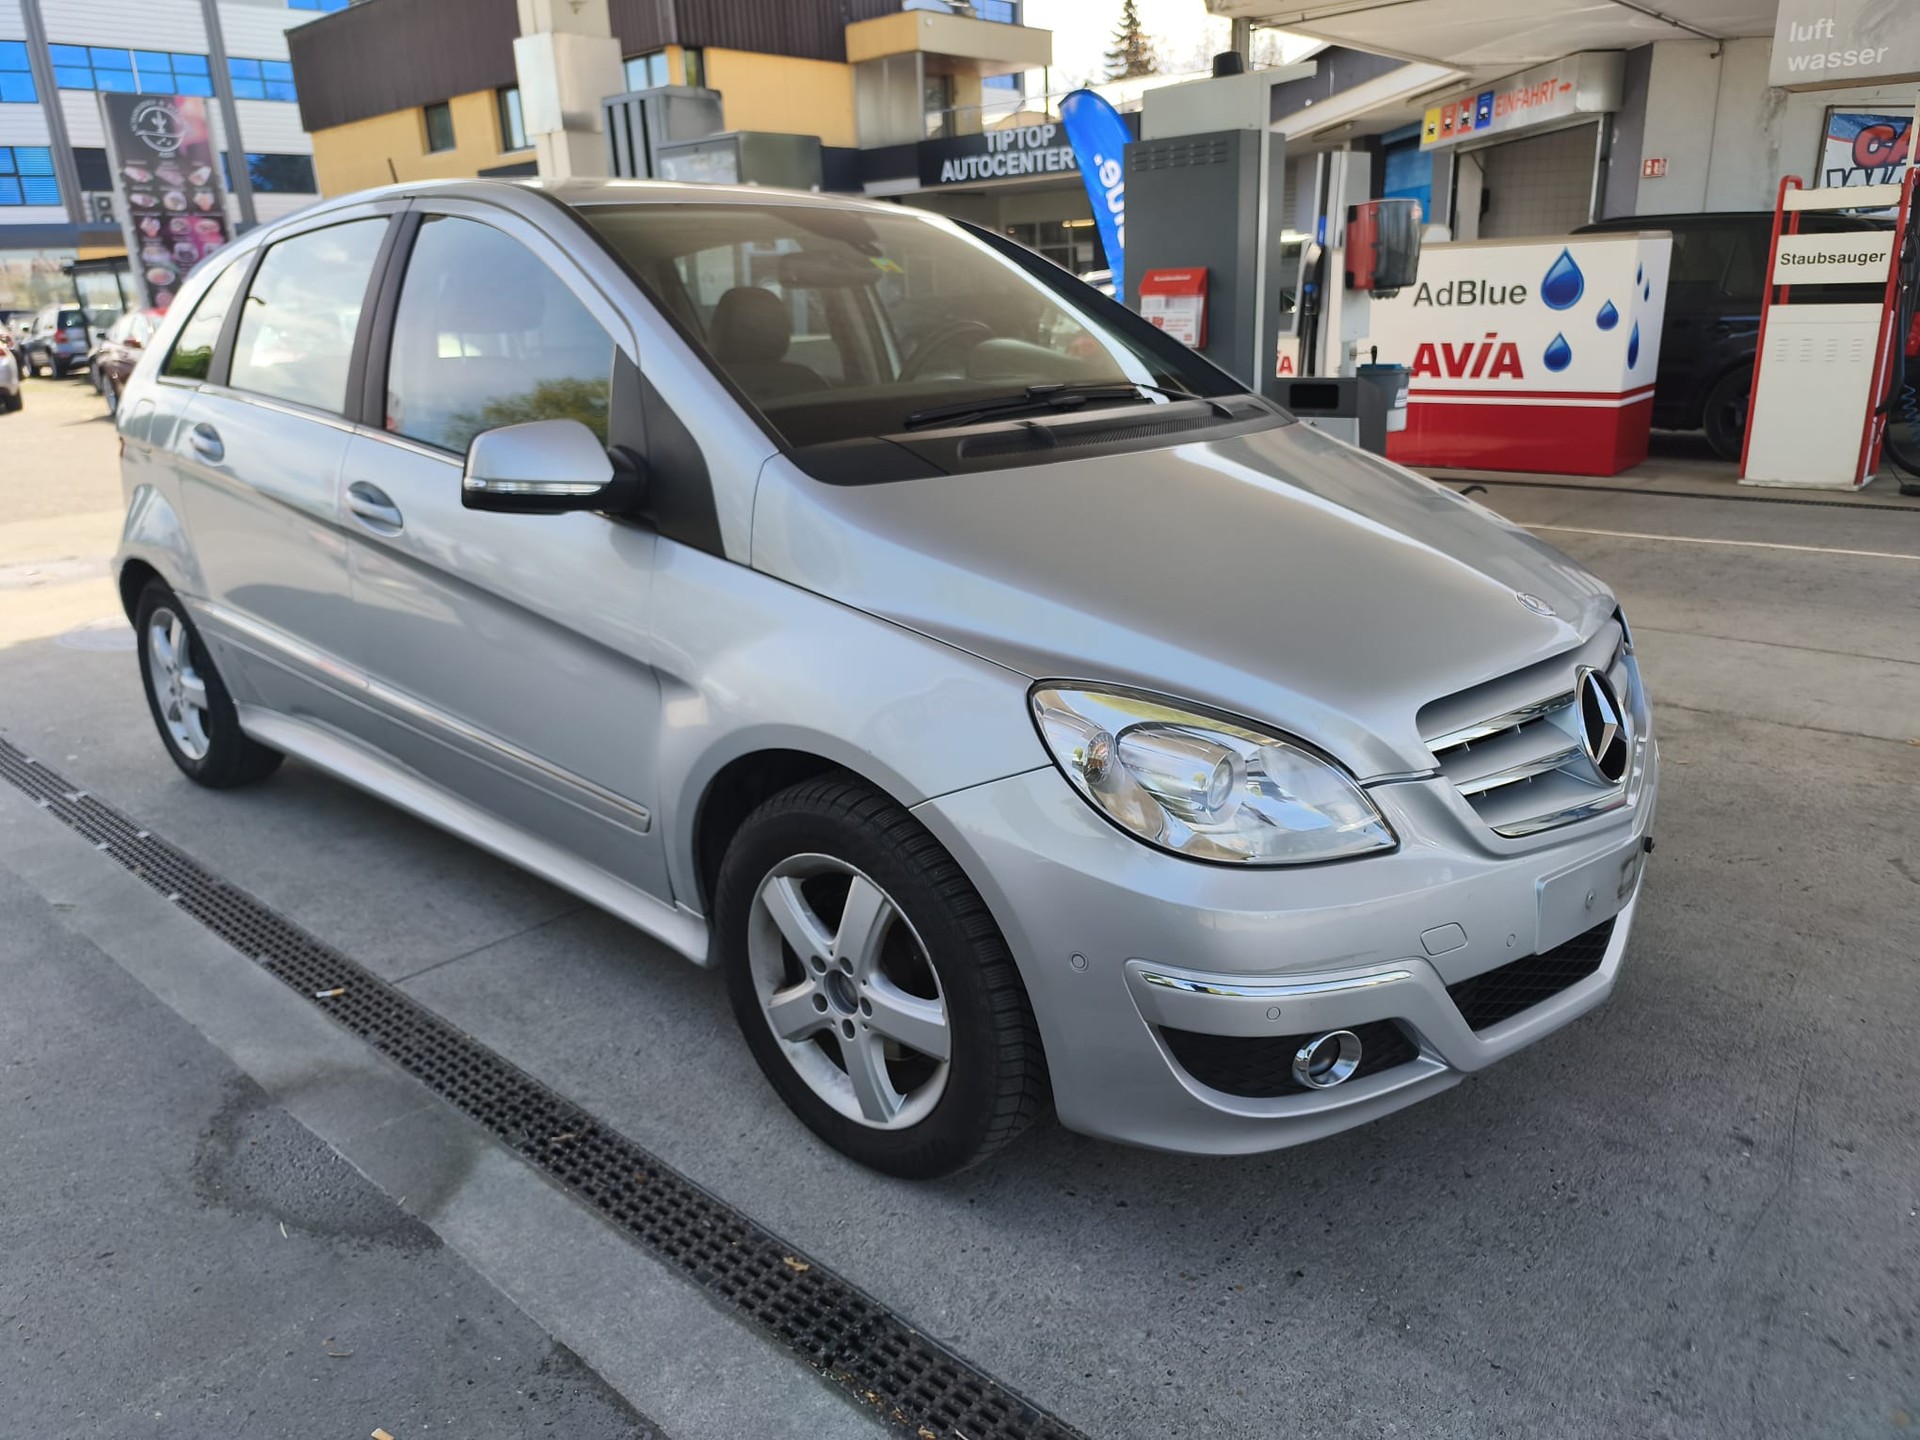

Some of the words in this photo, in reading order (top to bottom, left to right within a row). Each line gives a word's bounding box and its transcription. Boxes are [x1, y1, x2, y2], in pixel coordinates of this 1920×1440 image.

[1789, 18, 1835, 42] luft
[1787, 47, 1889, 72] wasser
[1494, 78, 1558, 118] EINFAHRT
[984, 123, 1057, 153] TIPTOP
[940, 146, 1076, 183] AUTOCENTER
[1780, 252, 1887, 266] Staubsauger
[1413, 279, 1528, 307] AdBlue
